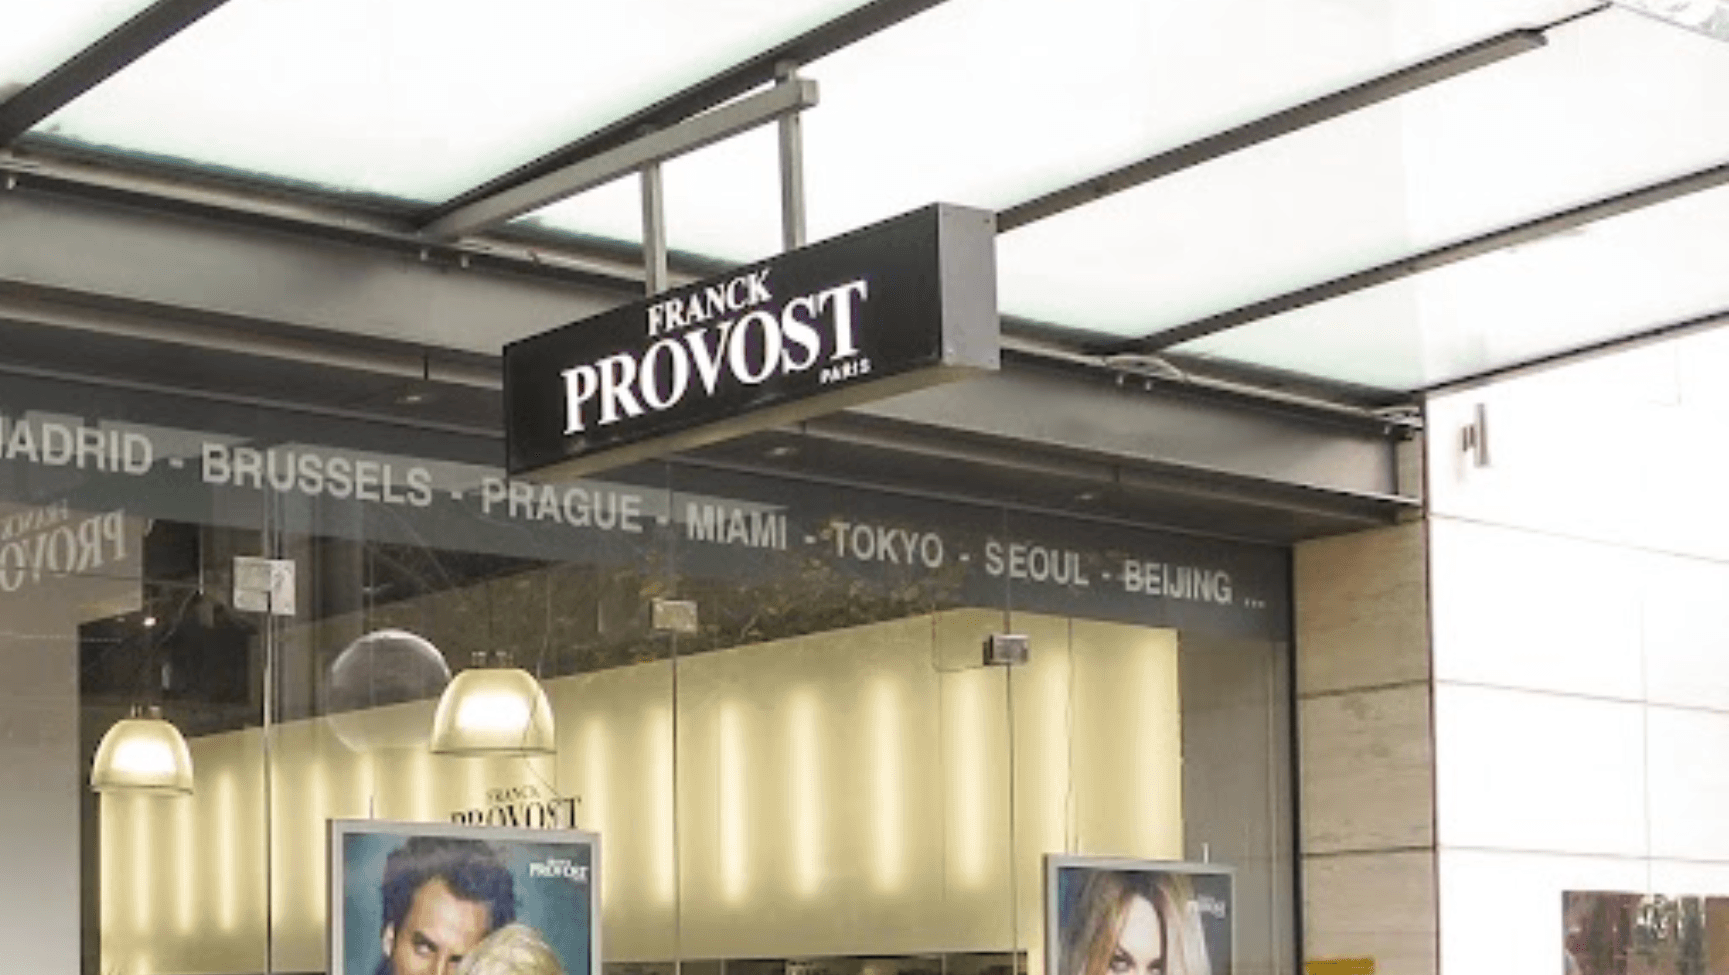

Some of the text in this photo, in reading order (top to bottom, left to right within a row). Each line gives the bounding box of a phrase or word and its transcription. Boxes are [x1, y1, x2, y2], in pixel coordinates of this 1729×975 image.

[560, 279, 869, 435] PROVOST
[647, 266, 774, 338] FRANCK
[819, 358, 872, 386] PARIS
[201, 442, 434, 507] BRUSSELS
[481, 477, 643, 534] PRAGUE
[686, 502, 788, 550] MIAMI
[831, 520, 944, 569] TOKYO
[985, 540, 1090, 588] SEOUL
[1124, 558, 1233, 604] BEIJING
